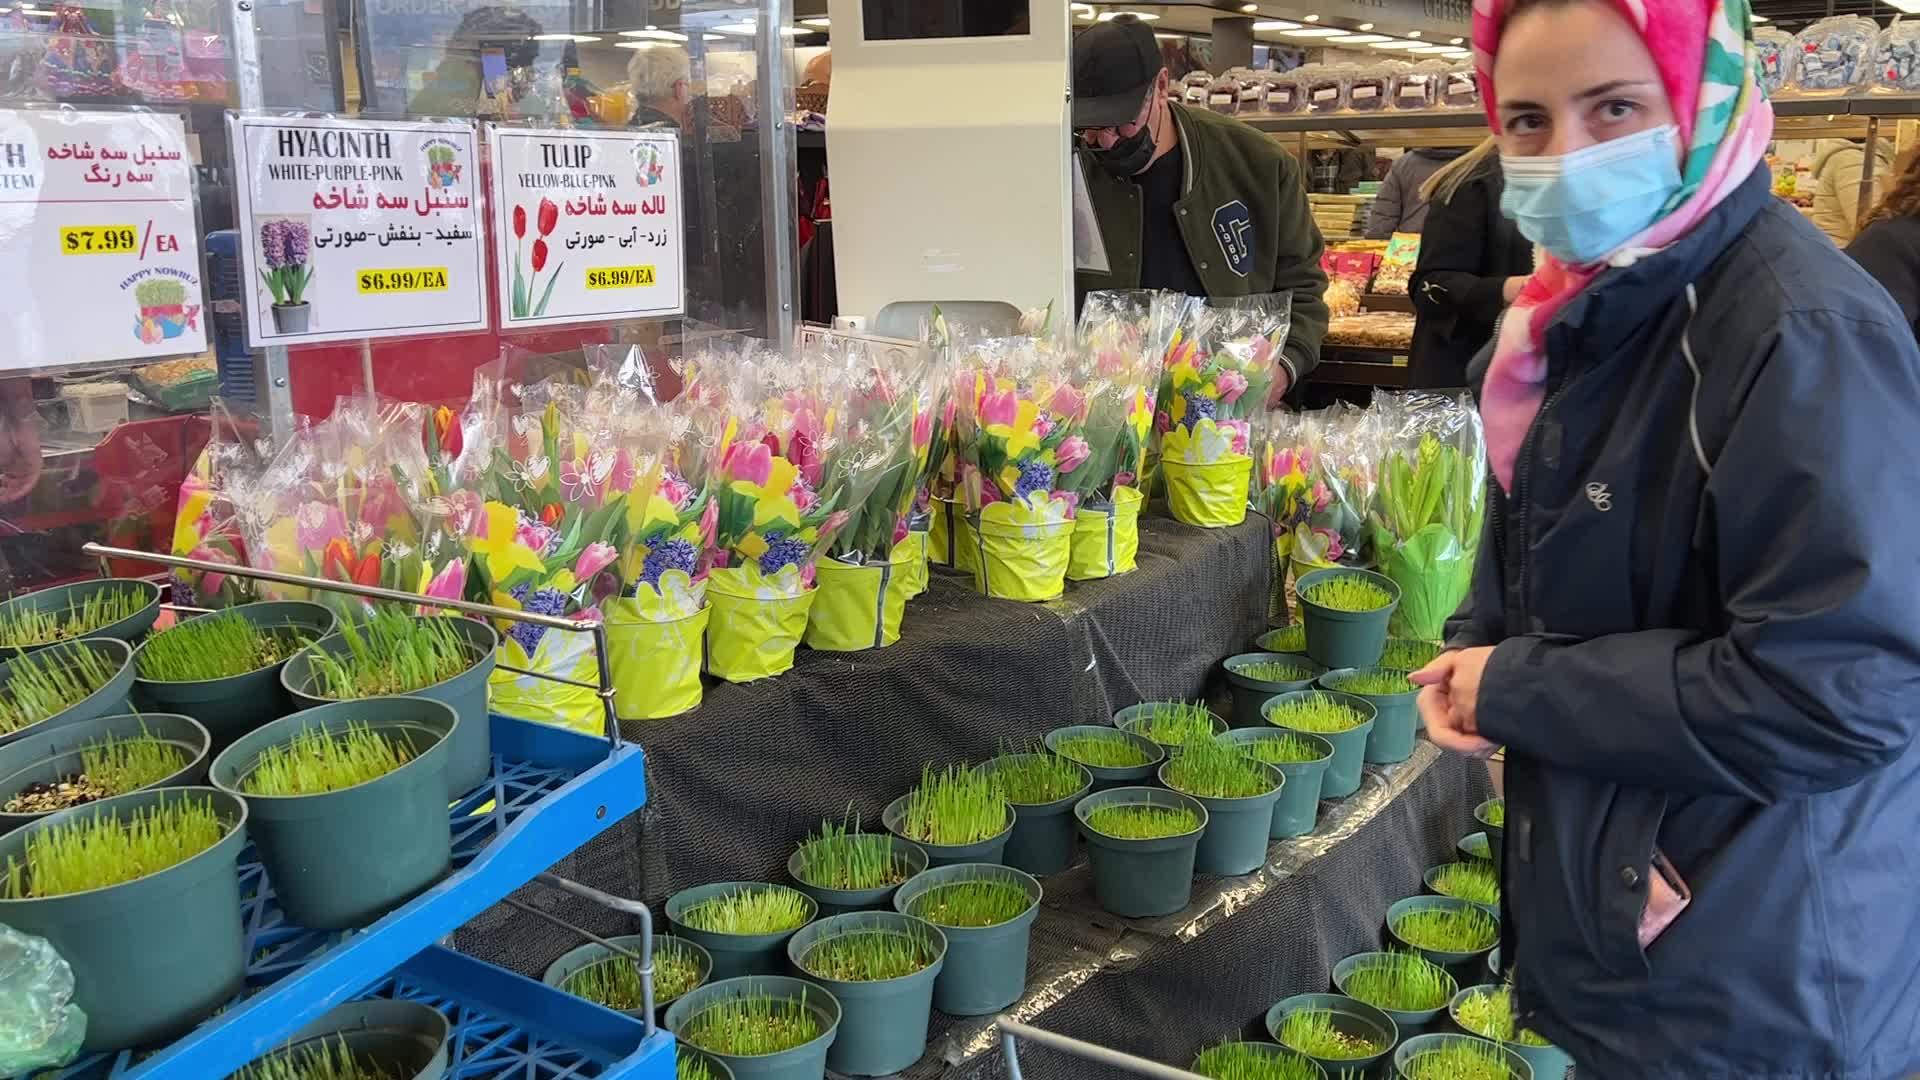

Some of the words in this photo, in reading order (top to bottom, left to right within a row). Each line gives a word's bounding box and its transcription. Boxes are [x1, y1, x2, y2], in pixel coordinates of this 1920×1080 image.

[47, 141, 95, 161] شاخه
[278, 129, 392, 160] HYACINTH
[100, 149, 128, 161] سه
[133, 144, 182, 166] سنبل
[540, 144, 593, 169] TULIP
[0, 174, 35, 190] TEM
[84, 163, 121, 187] رنگ
[127, 171, 153, 183] سه
[268, 163, 404, 182] WHITE-PURPLE-PINK
[518, 173, 617, 189] YELLOW-BLUE-PINK
[313, 184, 369, 209] شاخه
[376, 192, 408, 209] سه
[415, 187, 469, 216] سنبل
[565, 193, 607, 216] شاخه
[641, 195, 665, 215] لاله
[612, 199, 637, 215] سه
[565, 231, 606, 249] صورتی
[120, 268, 152, 291] HAPPY
[154, 266, 198, 285] NOWRUZ
[361, 271, 446, 290] $6.99/EA
[589, 269, 654, 286] $6.99/EA
